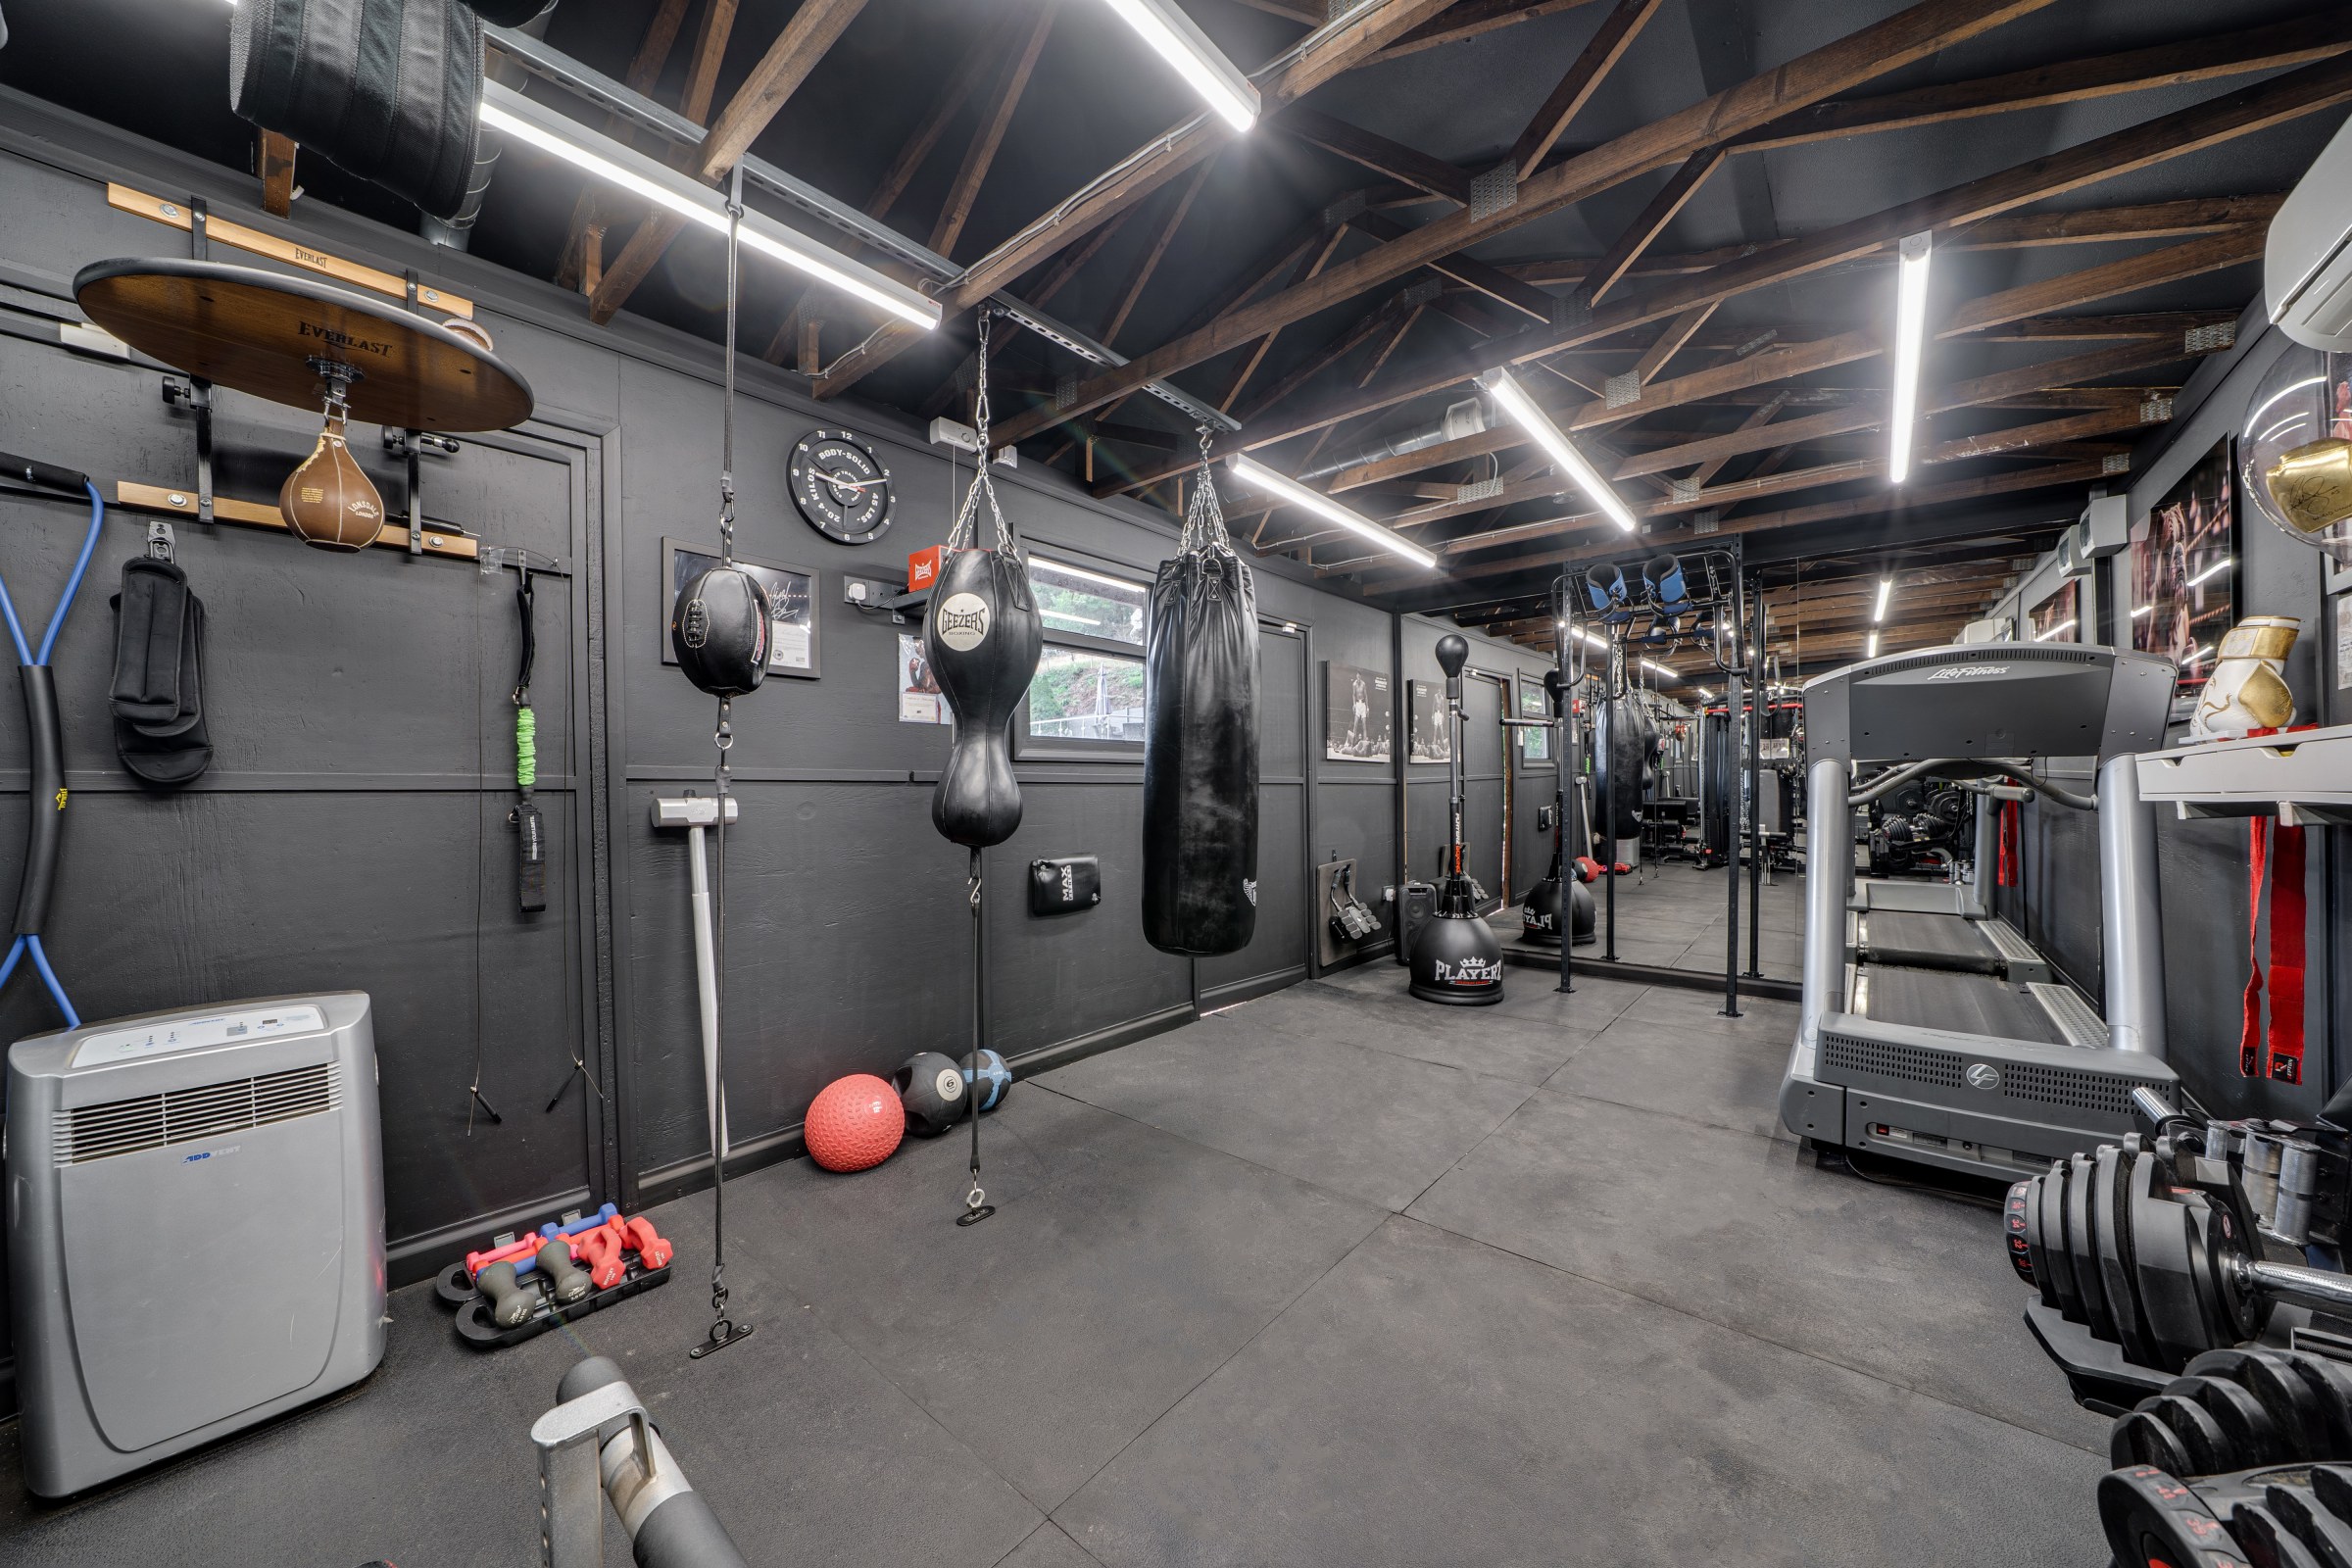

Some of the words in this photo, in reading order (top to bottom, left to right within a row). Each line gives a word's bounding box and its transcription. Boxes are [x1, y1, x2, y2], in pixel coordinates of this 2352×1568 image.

[295, 248, 327, 269] EVERLAST
[298, 320, 392, 357] EVERLAST
[817, 430, 825, 439] 11
[841, 431, 853, 440] 12
[799, 443, 808, 452] 10
[818, 448, 870, 475] BODY-SOLID
[808, 467, 819, 501] KILOS
[348, 501, 379, 516] LONSDALE
[871, 492, 879, 507] 45
[818, 503, 840, 522] 20.4
[942, 607, 986, 636] GEEZERS
[1060, 866, 1069, 901] MAX
[1434, 958, 1501, 981] PLAYERZ
[946, 1078, 955, 1087] 6
[2014, 1239, 2023, 1250] 32
